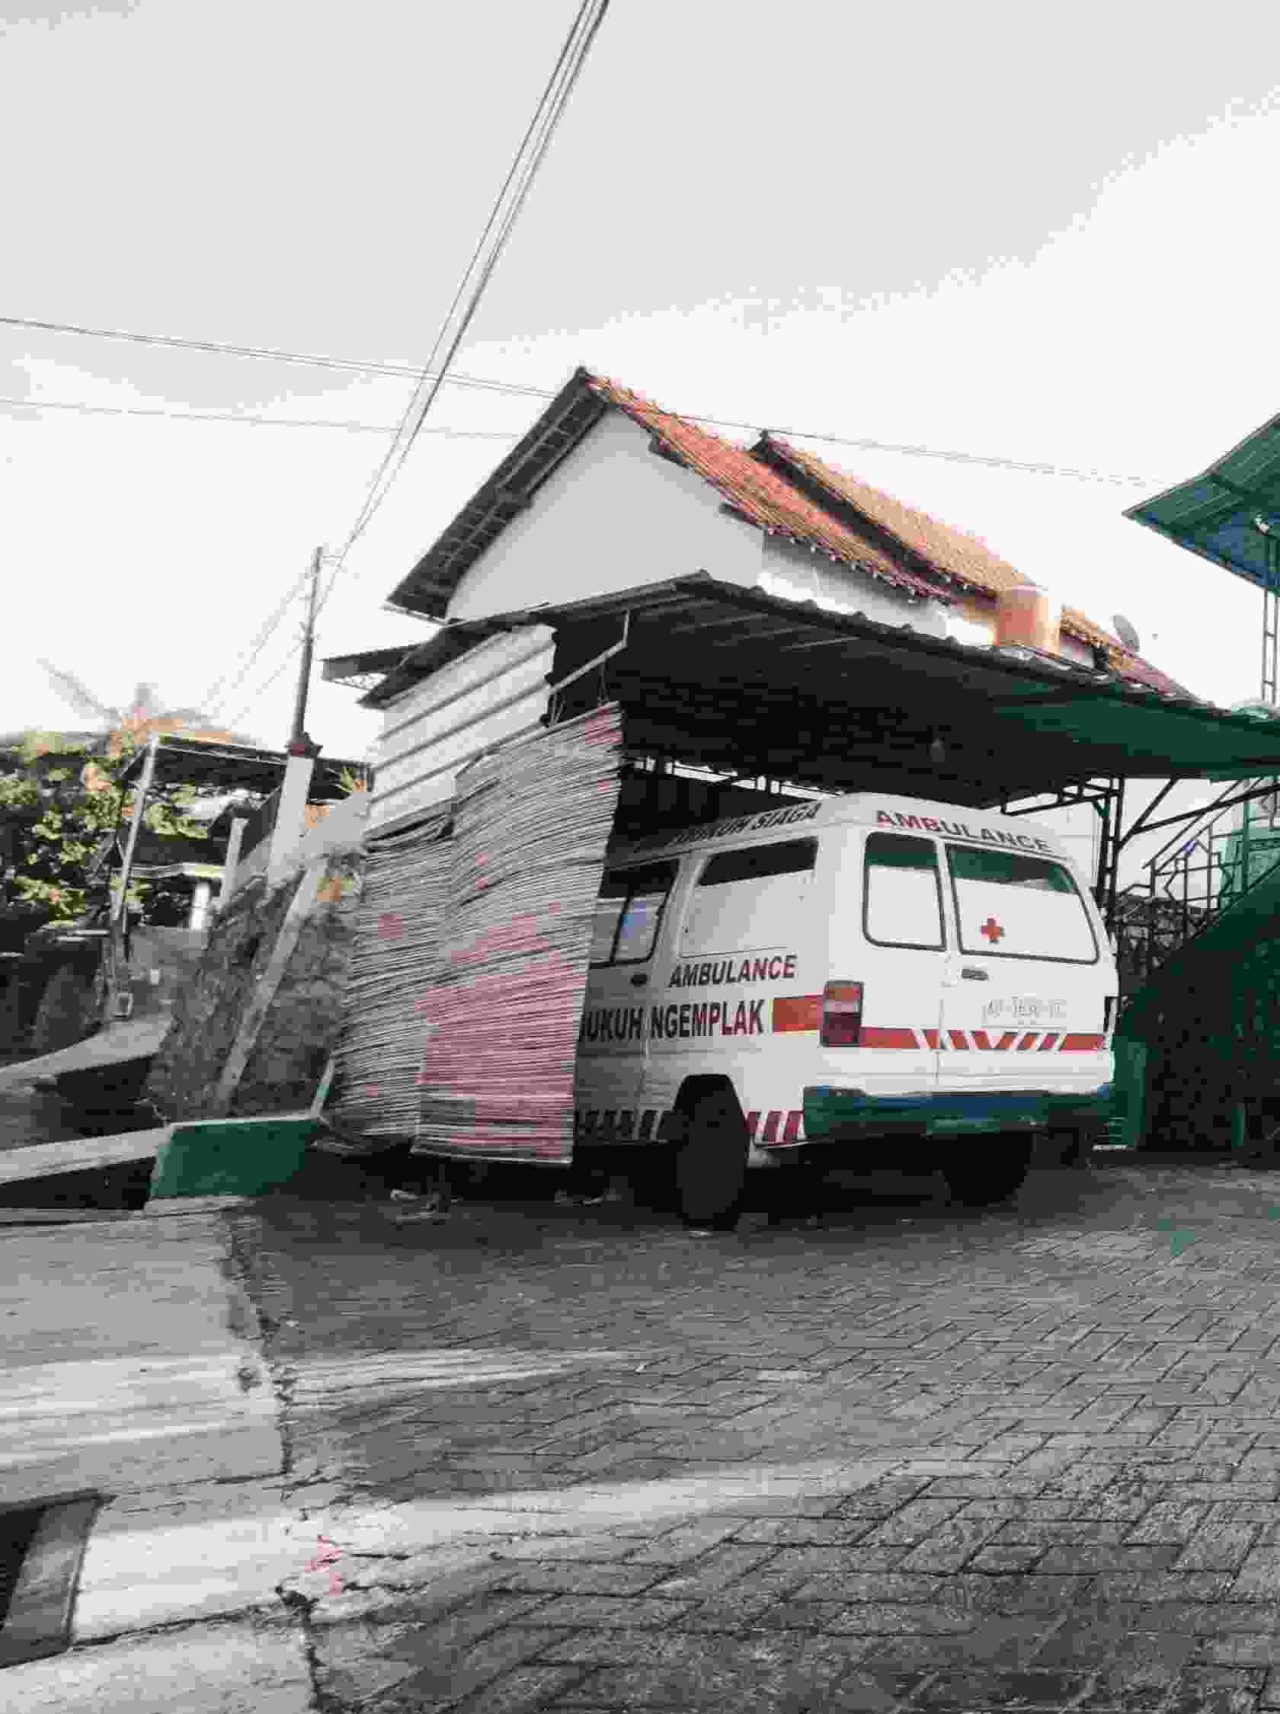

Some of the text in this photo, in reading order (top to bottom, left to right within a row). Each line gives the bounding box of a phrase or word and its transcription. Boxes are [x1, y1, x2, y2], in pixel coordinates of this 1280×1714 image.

[876, 810, 1051, 850] AMBULANCE
[668, 954, 798, 989] AMBULANCE
[651, 999, 765, 1040] NGEMPLAK
